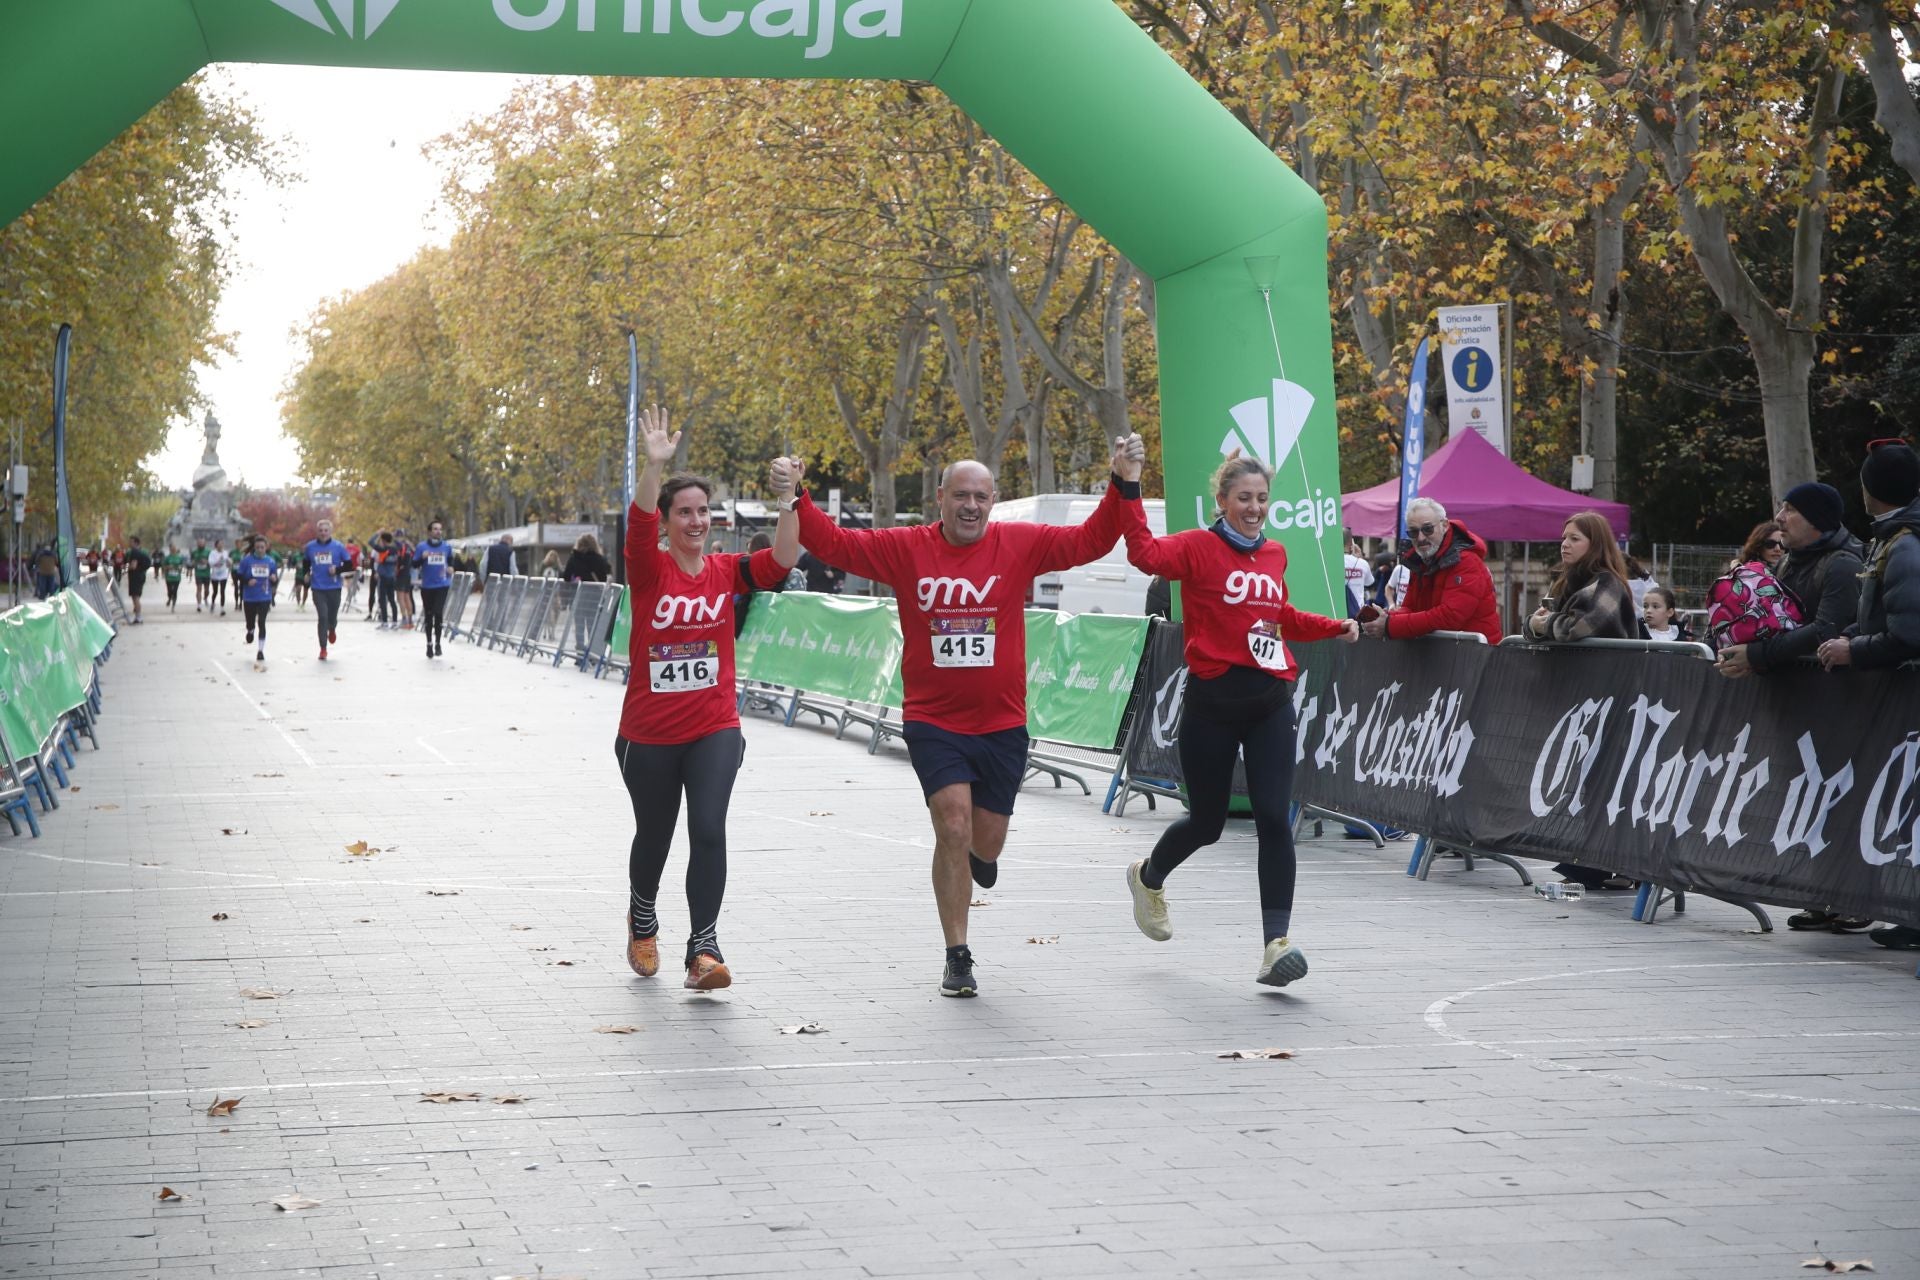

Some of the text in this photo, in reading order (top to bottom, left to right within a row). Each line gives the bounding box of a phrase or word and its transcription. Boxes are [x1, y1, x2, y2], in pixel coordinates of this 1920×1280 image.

[1446, 314, 1483, 324] Oficina de
[1195, 488, 1337, 539] Ucaja
[652, 593, 726, 629] gmv
[917, 575, 997, 612] gmv
[939, 636, 985, 657] 415
[1252, 637, 1276, 660] 417
[660, 660, 709, 682] 416
[1314, 681, 1358, 775] de
[1354, 680, 1476, 800] Castilla
[1529, 695, 1614, 818] El
[1606, 693, 1770, 848] Norte
[1770, 730, 1855, 859] de
